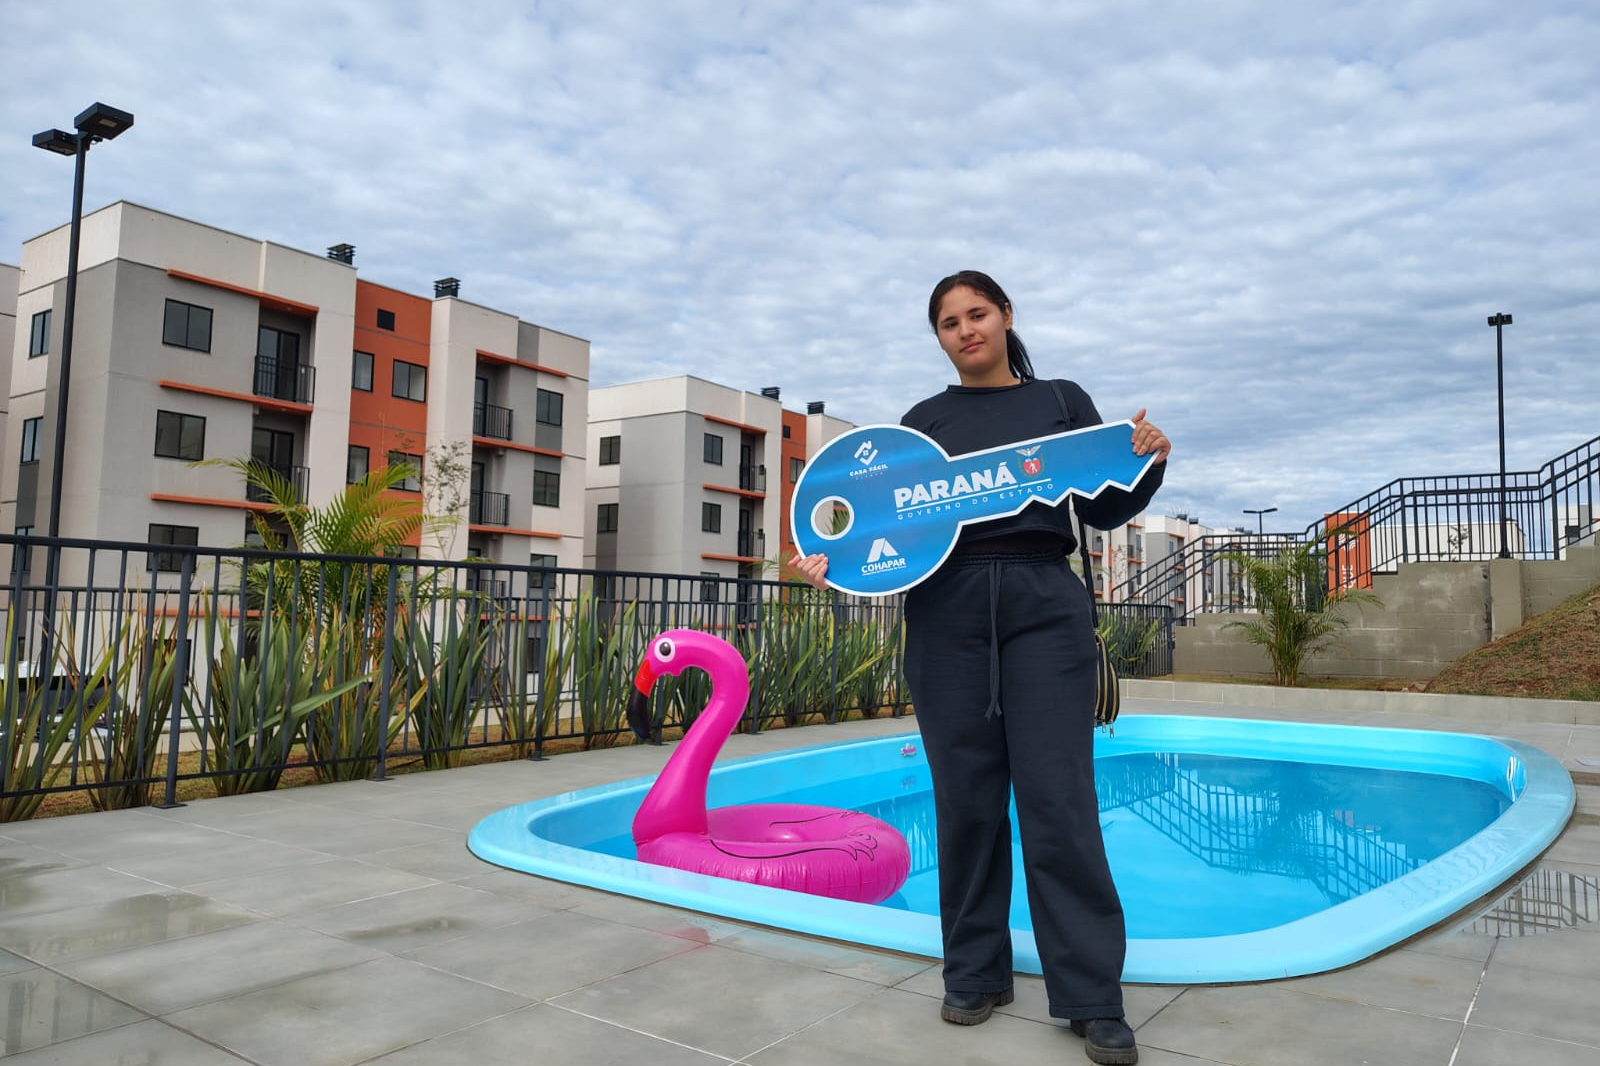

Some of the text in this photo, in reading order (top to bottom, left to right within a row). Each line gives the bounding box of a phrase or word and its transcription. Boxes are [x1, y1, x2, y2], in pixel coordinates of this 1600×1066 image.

[894, 461, 1018, 509] PARANÁ
[897, 483, 1054, 520] GOVERNO DO ESTADO
[861, 557, 906, 574] COHAPAR
